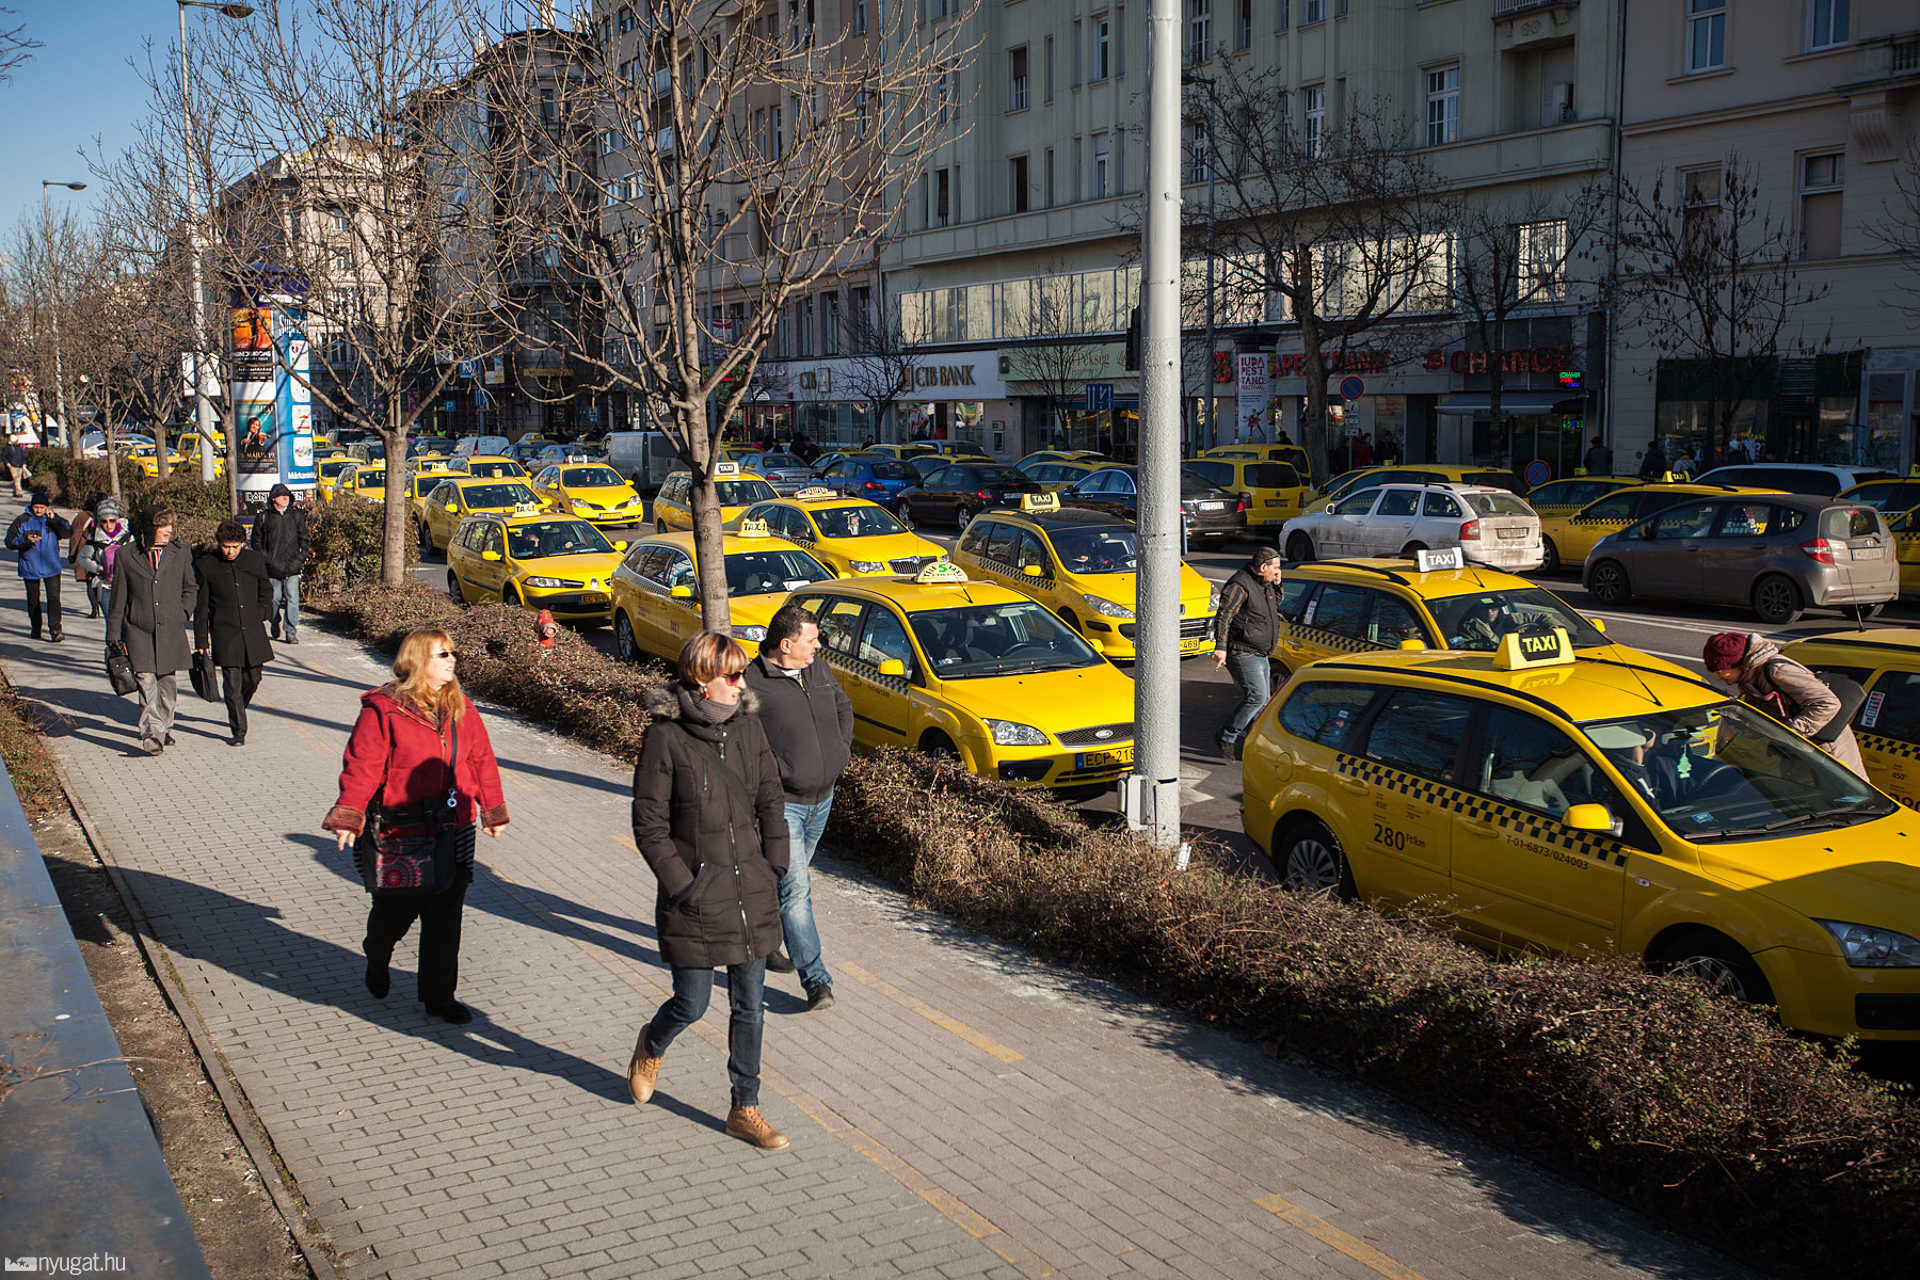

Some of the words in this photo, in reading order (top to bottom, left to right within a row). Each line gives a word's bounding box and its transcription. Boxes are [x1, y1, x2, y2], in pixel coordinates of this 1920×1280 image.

[915, 367, 938, 387] CIB
[939, 364, 977, 387] BANK
[719, 464, 735, 472] TAXI
[1031, 495, 1053, 504] TAXI
[1426, 553, 1456, 566] TAXI
[938, 564, 948, 573] 5
[1520, 635, 1558, 653] TAXI
[1374, 824, 1404, 850] 280
